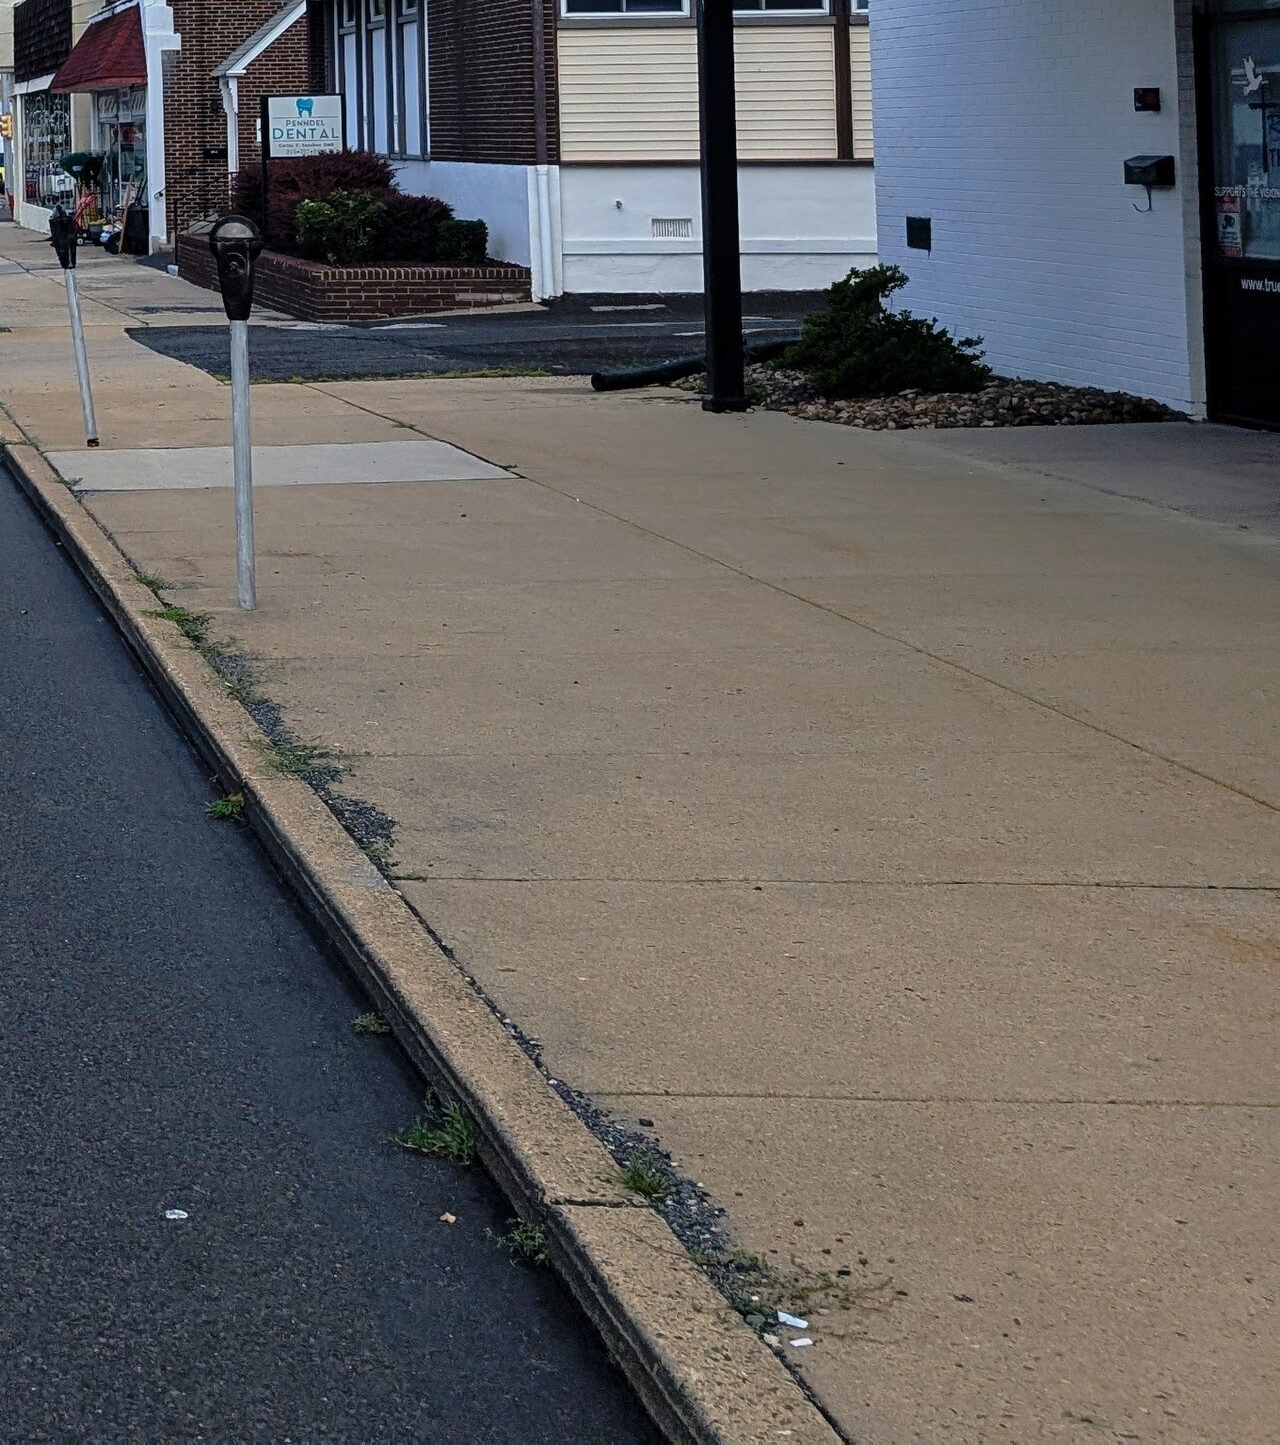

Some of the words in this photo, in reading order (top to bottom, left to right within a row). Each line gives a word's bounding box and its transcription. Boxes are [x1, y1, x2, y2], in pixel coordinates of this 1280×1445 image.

[285, 119, 326, 127] PENNDEL
[272, 127, 339, 140] DENTAL
[1214, 186, 1246, 197] SUPPORTS
[1246, 187, 1259, 198] THE
